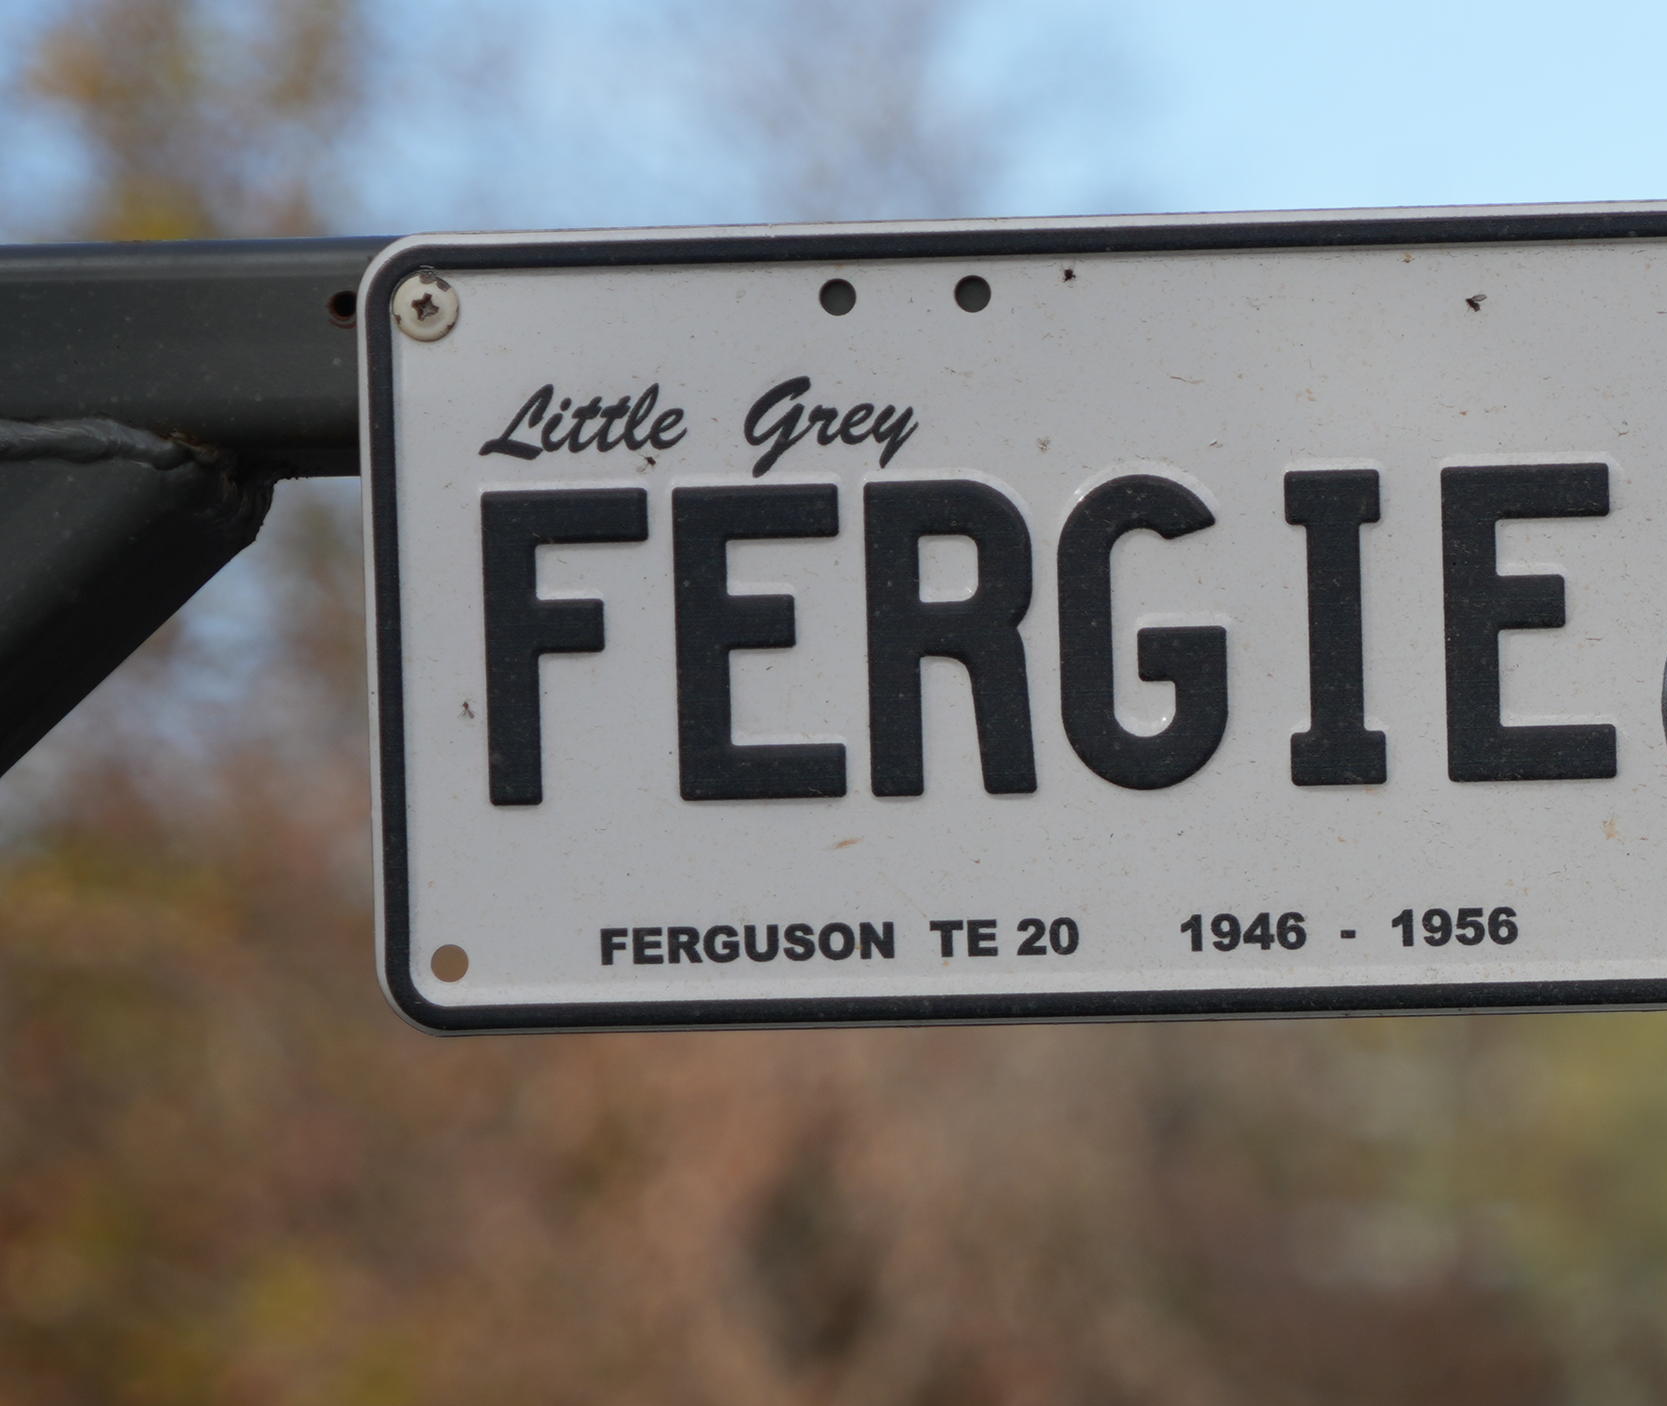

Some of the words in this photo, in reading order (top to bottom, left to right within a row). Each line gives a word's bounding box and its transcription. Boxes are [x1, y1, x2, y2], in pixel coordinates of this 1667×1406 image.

[479, 383, 687, 457] Little
[743, 377, 919, 476] Grey
[480, 462, 1618, 807] FERGIE
[600, 921, 895, 966] FERGUSON
[1180, 911, 1307, 952] 1946
[1391, 906, 1519, 947] 1956
